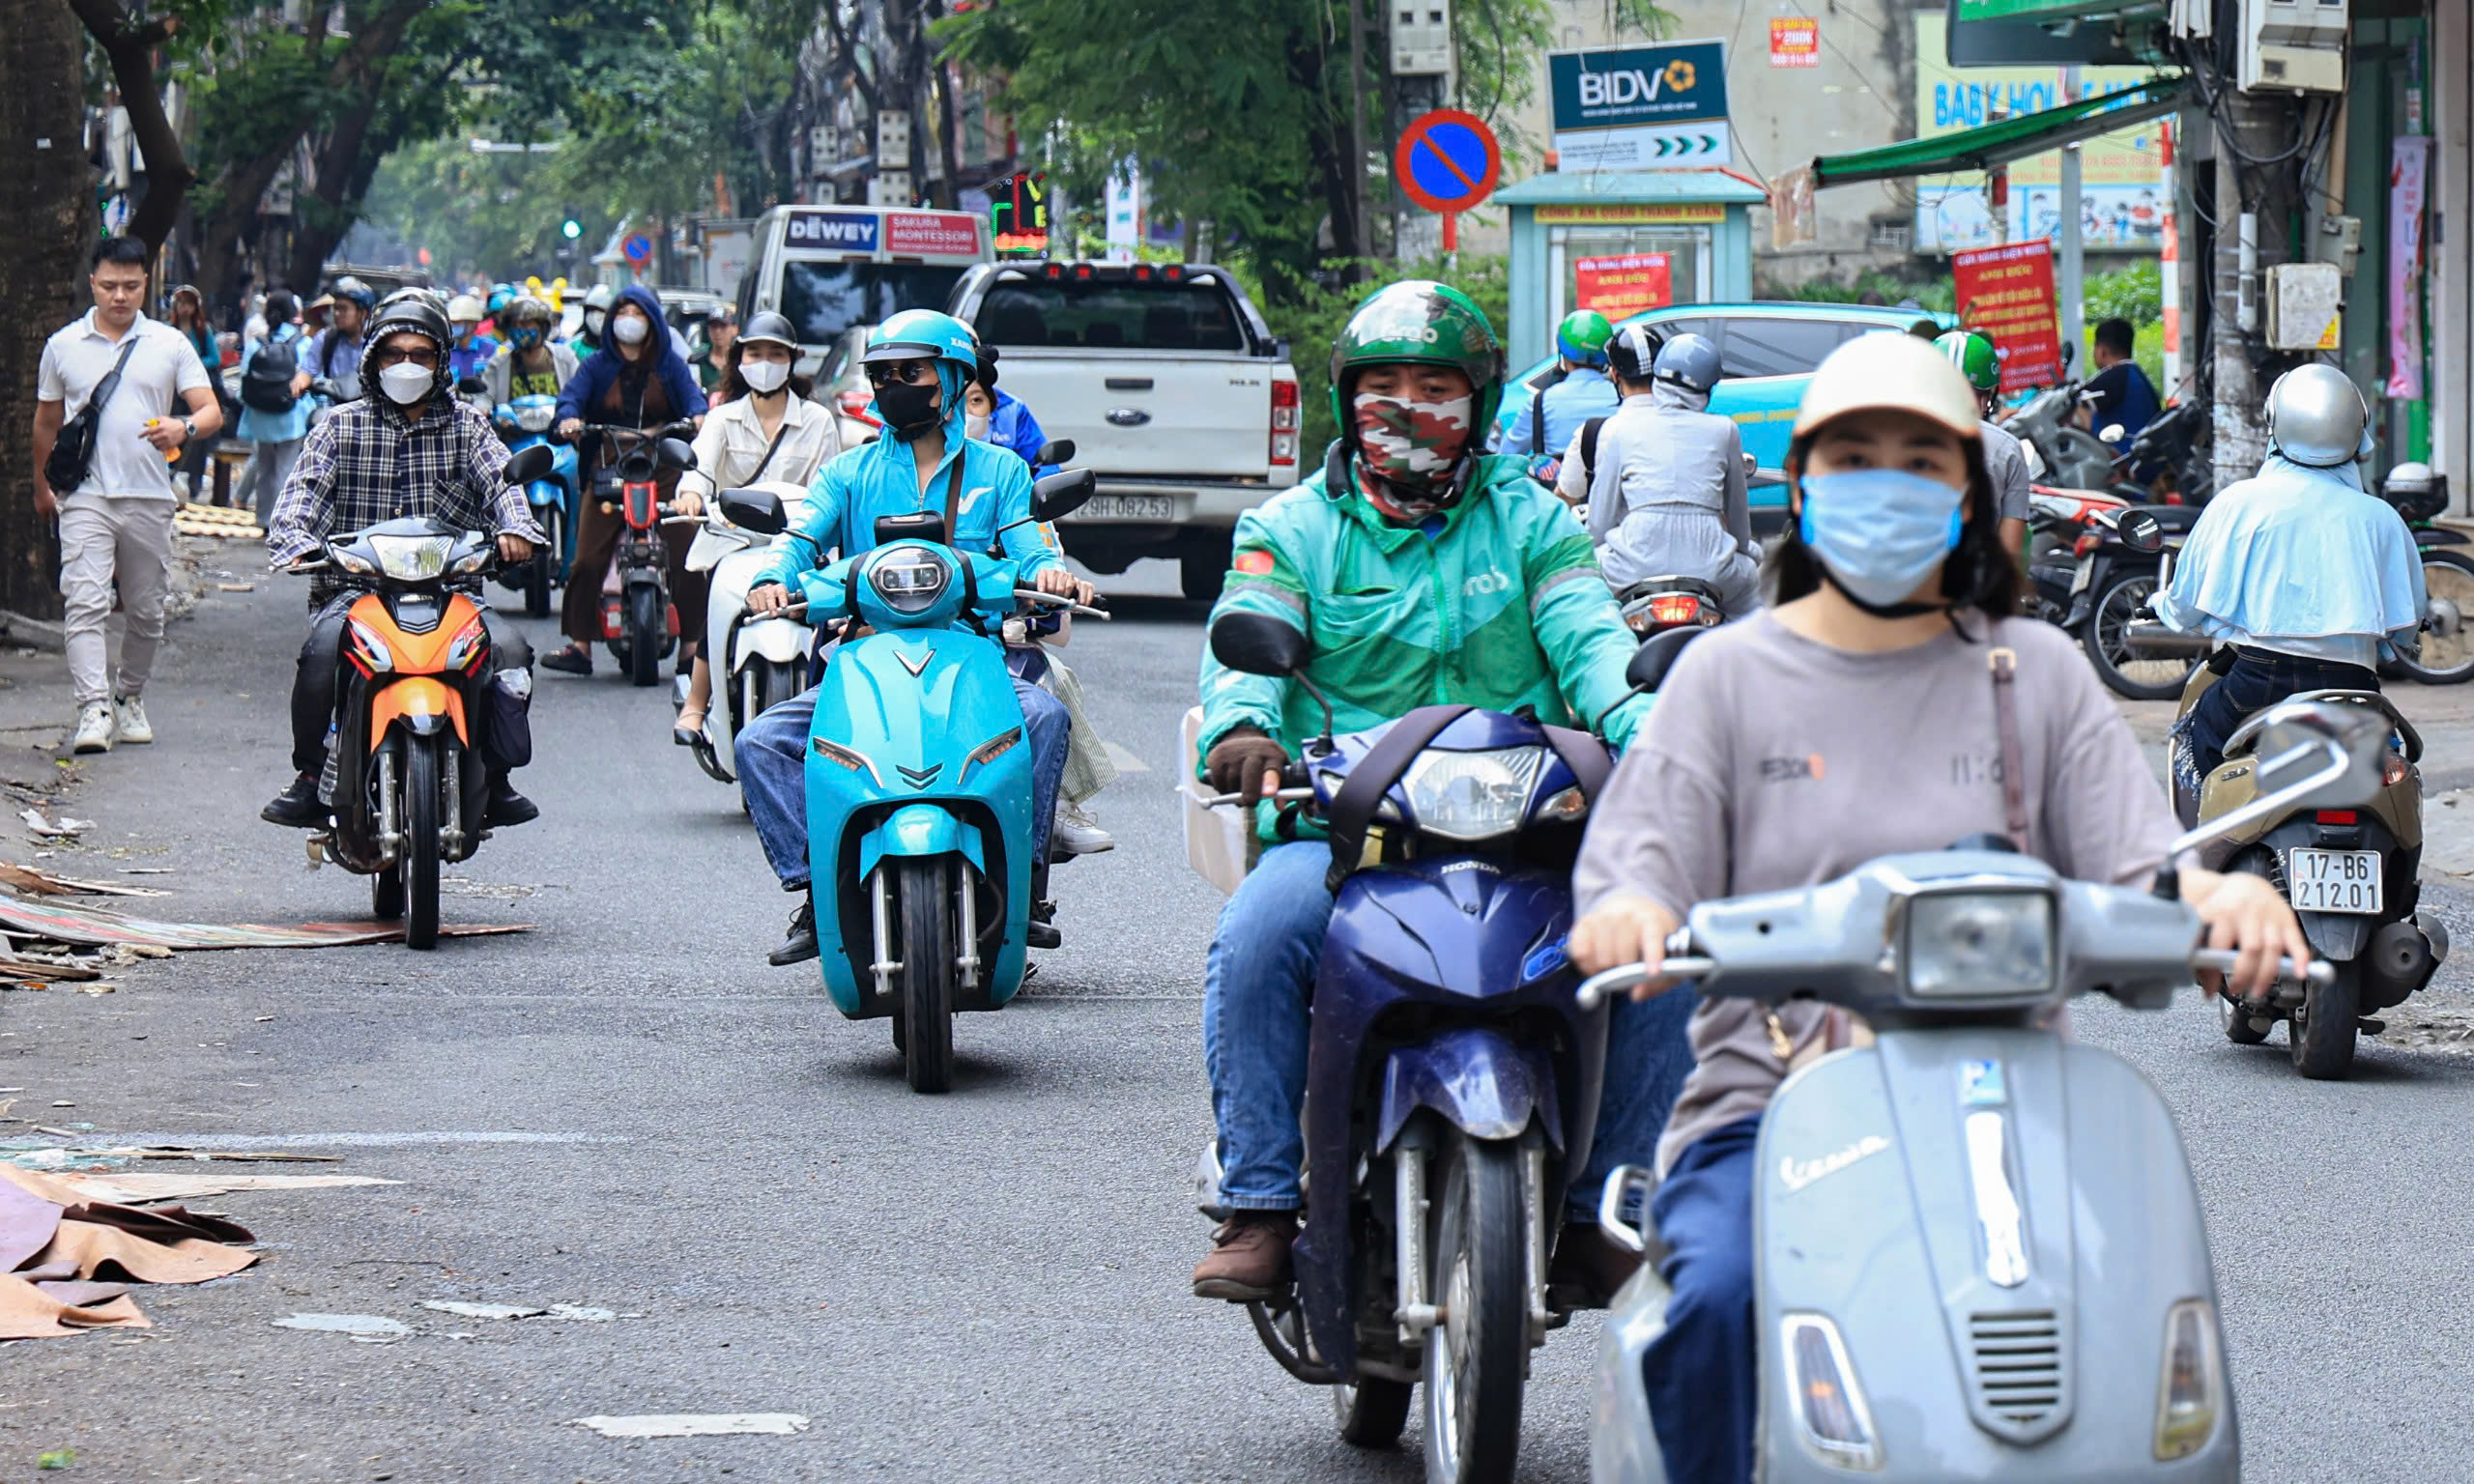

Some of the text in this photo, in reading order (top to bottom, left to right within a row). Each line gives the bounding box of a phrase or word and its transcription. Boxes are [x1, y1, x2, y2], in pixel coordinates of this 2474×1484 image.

[1579, 68, 1664, 106] BIDV
[1441, 859, 1501, 874] HONDA
[2307, 853, 2369, 881] 17-B6
[2297, 881, 2376, 909] 212.01
